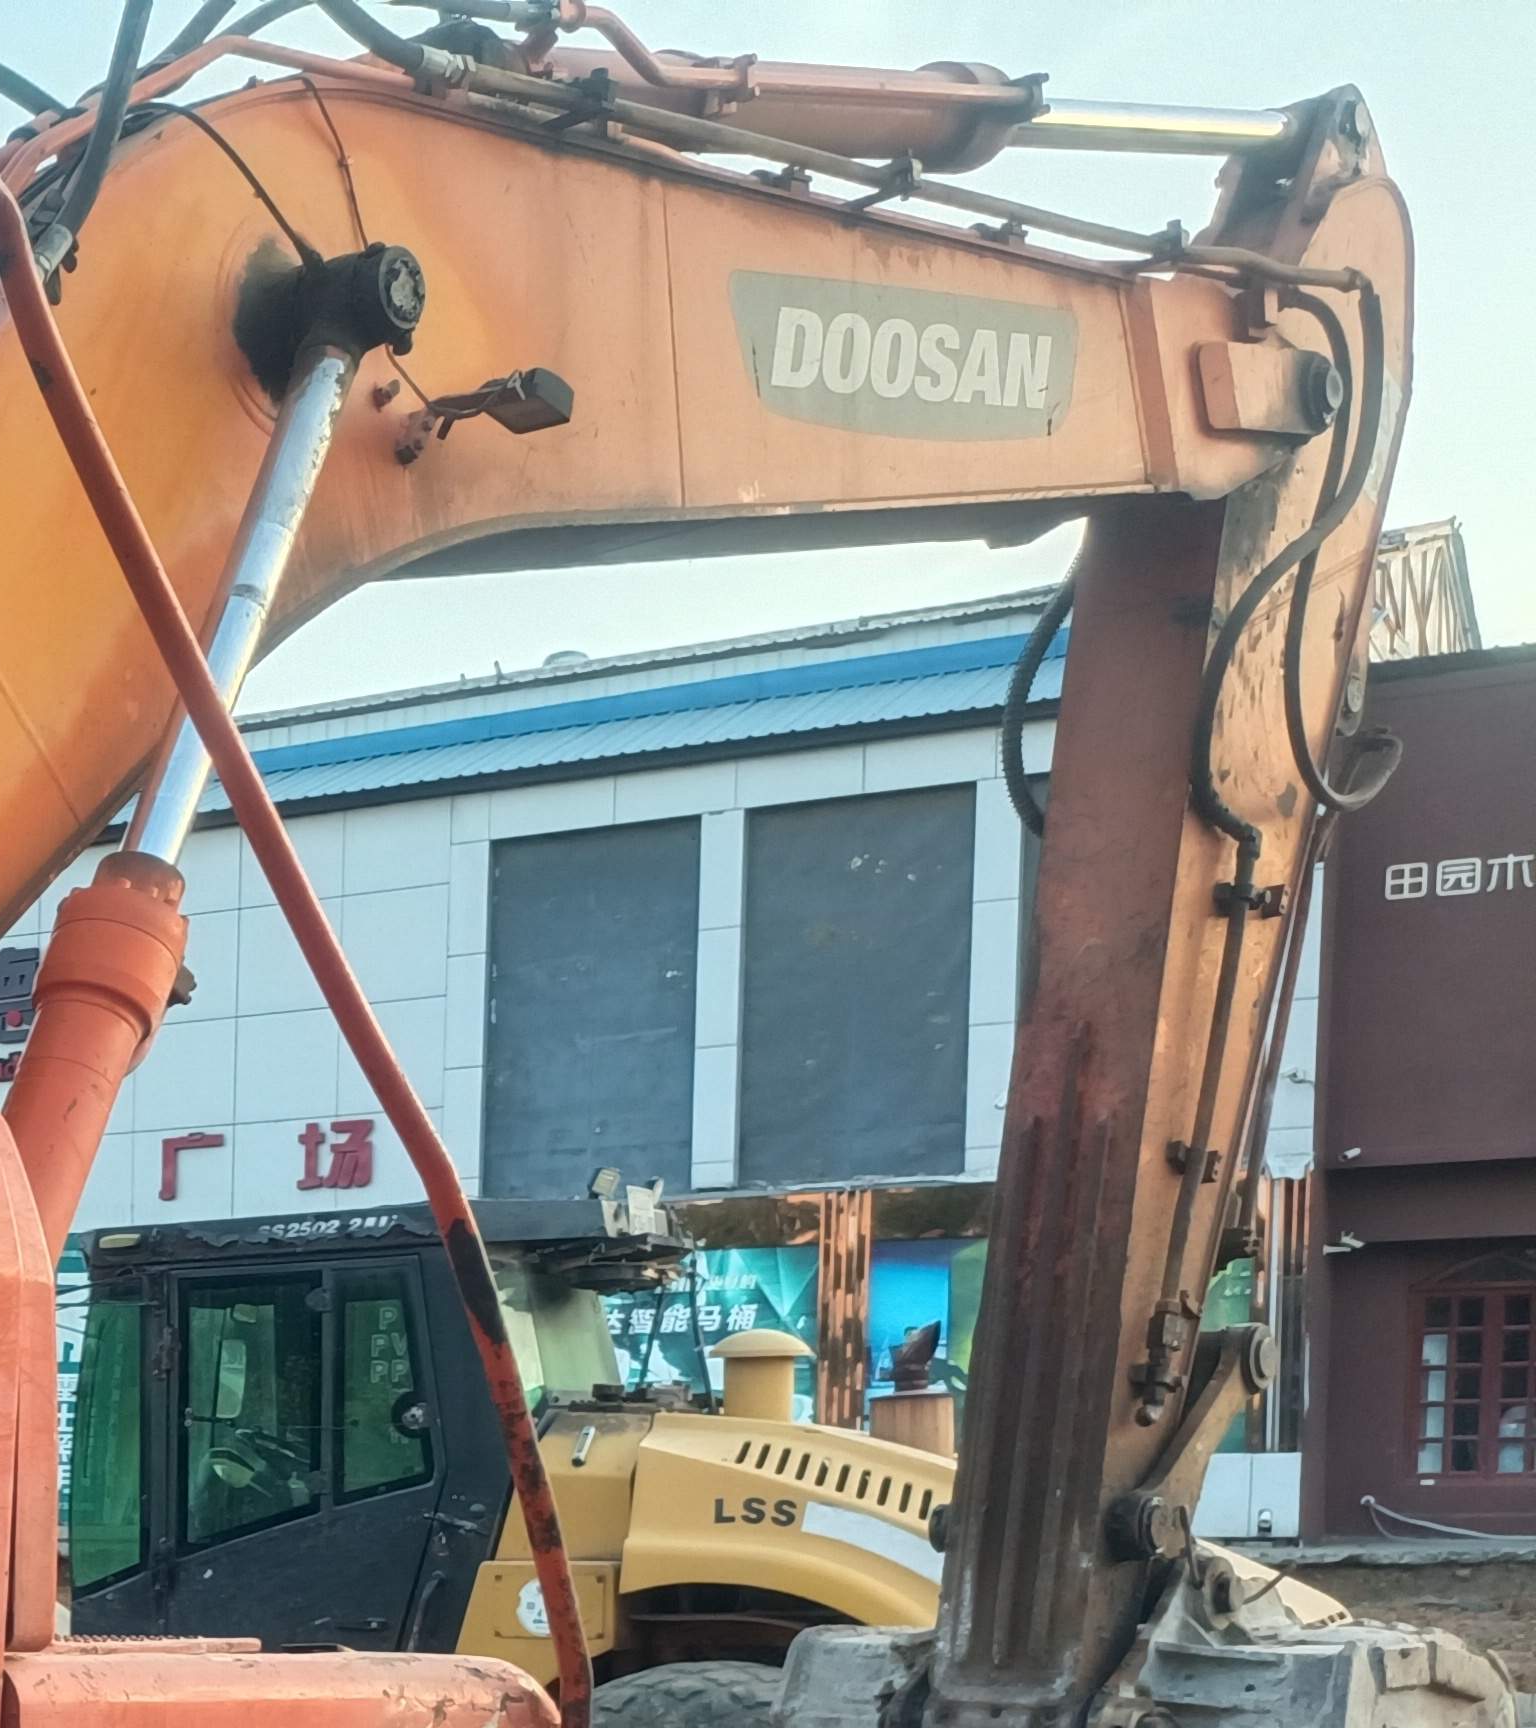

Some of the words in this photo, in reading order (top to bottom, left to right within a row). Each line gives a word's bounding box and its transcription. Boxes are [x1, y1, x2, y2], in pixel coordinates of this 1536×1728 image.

[771, 306, 1052, 409] DOOSAN
[1384, 853, 1535, 901] 田园木
[159, 1119, 374, 1201] 广场
[714, 1497, 798, 1526] LSS
